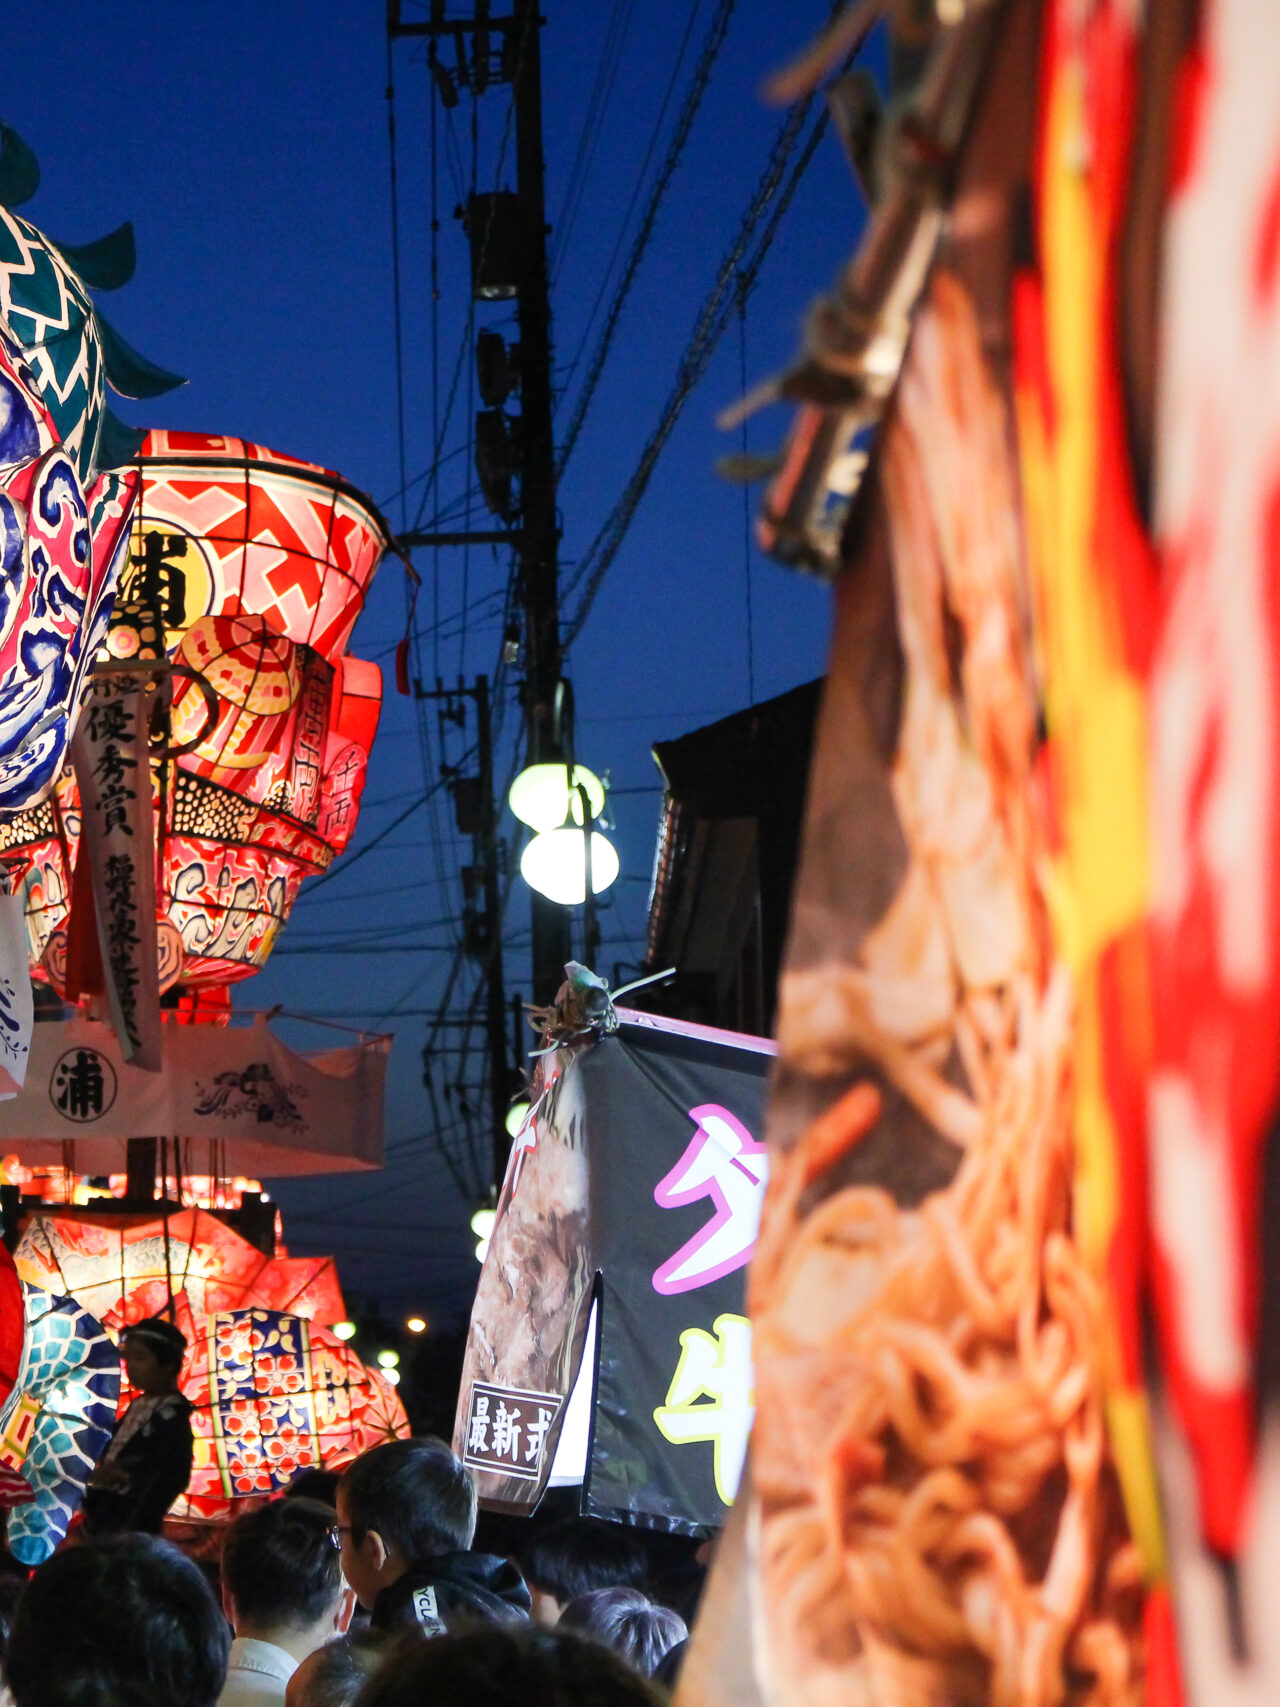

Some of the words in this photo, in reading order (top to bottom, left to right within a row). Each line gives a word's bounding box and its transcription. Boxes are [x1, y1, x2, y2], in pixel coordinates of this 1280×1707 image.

[85, 701, 138, 835] 優秀賞
[324, 750, 359, 836] 千両
[56, 1051, 104, 1118] 浦
[469, 1396, 553, 1465] 最新式
